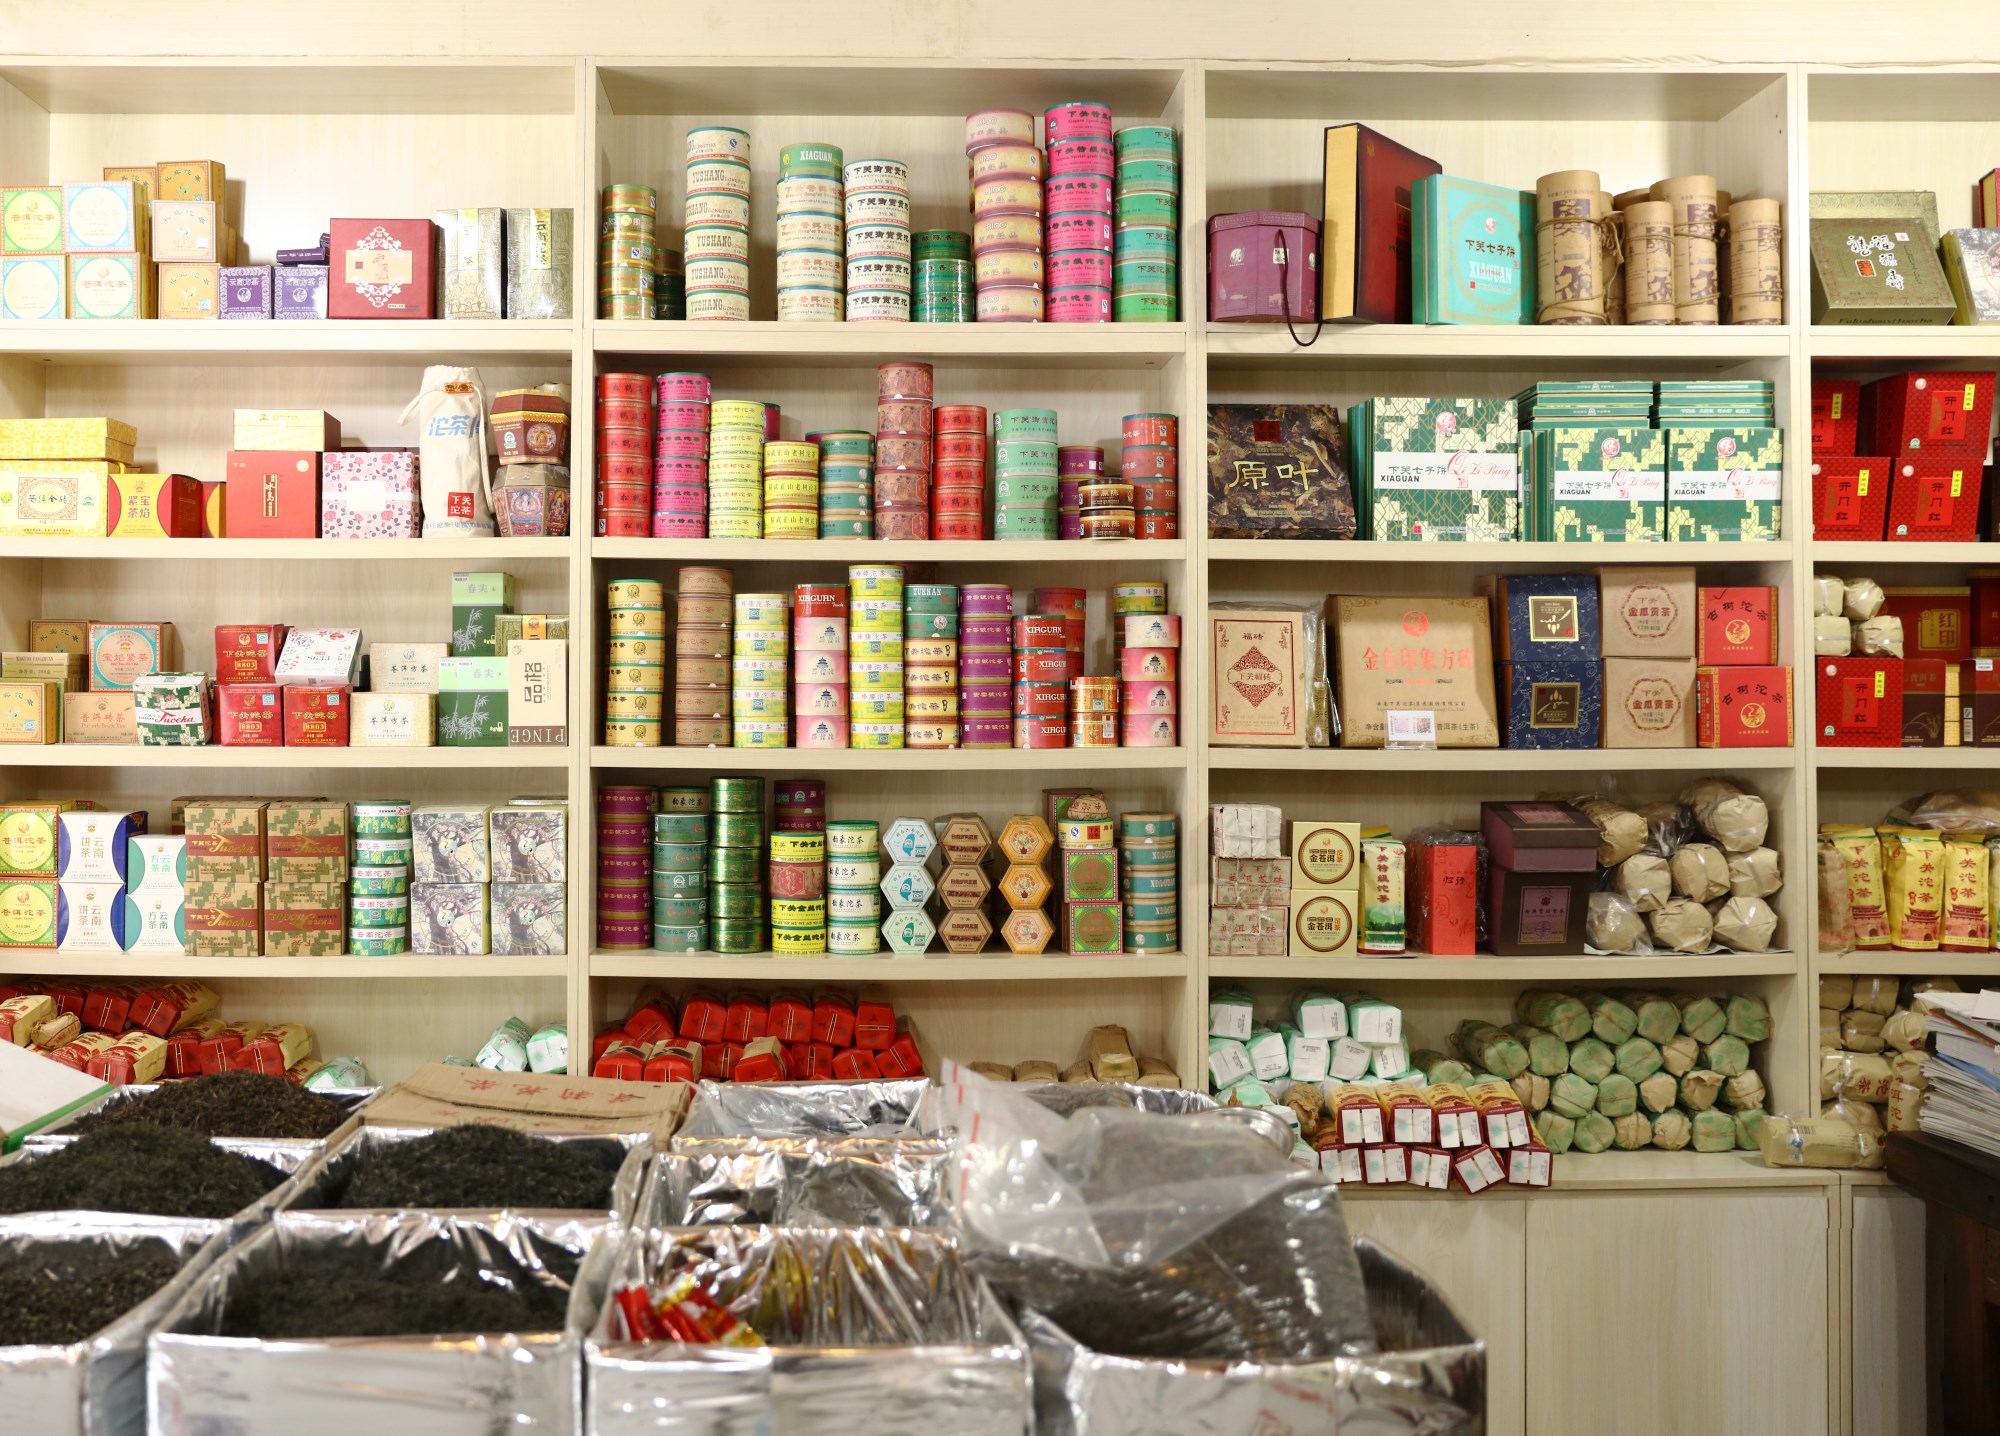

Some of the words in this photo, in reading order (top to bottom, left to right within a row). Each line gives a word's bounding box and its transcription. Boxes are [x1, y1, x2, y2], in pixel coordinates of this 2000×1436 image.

[800, 150, 833, 163] XIAGUAN
[692, 170, 725, 184] YUSHANG
[697, 235, 732, 247] YUSHANG
[691, 267, 724, 280] YUSHANG
[1469, 260, 1512, 285] XIAGUAN
[691, 299, 723, 313] YUSHANG
[1941, 396, 1957, 435] 开门红
[1229, 460, 1319, 490] 原叶
[1388, 465, 1447, 476] 下关七子饼
[1380, 475, 1420, 483] XIAGUAN
[1566, 481, 1611, 489] 下关七子饼
[1681, 481, 1727, 489] 下关七子饼
[450, 495, 472, 506] 下关
[1835, 481, 1851, 521] 开门红
[1928, 482, 1944, 521] 开门红
[450, 505, 472, 517] 沱茶
[1628, 607, 1671, 617] 金瓜贡茶
[1938, 612, 1955, 645] 红印
[1242, 632, 1264, 641] 福砖
[1362, 647, 1474, 671] 金色印象方砖
[1632, 700, 1674, 709] 金瓜贡茶
[1854, 683, 1868, 722] 开门红
[155, 707, 197, 723] Tuocha
[304, 723, 326, 731] 8803
[296, 819, 317, 827] 下关
[1309, 854, 1335, 863] 金苍洱
[1376, 845, 1390, 904] 下关特级沱茶
[1849, 845, 1873, 899] 下关沱茶
[1917, 849, 1935, 903] 下关沱茶
[1958, 847, 1977, 899] 下关沱茶
[1307, 922, 1333, 931] 金苍洱
